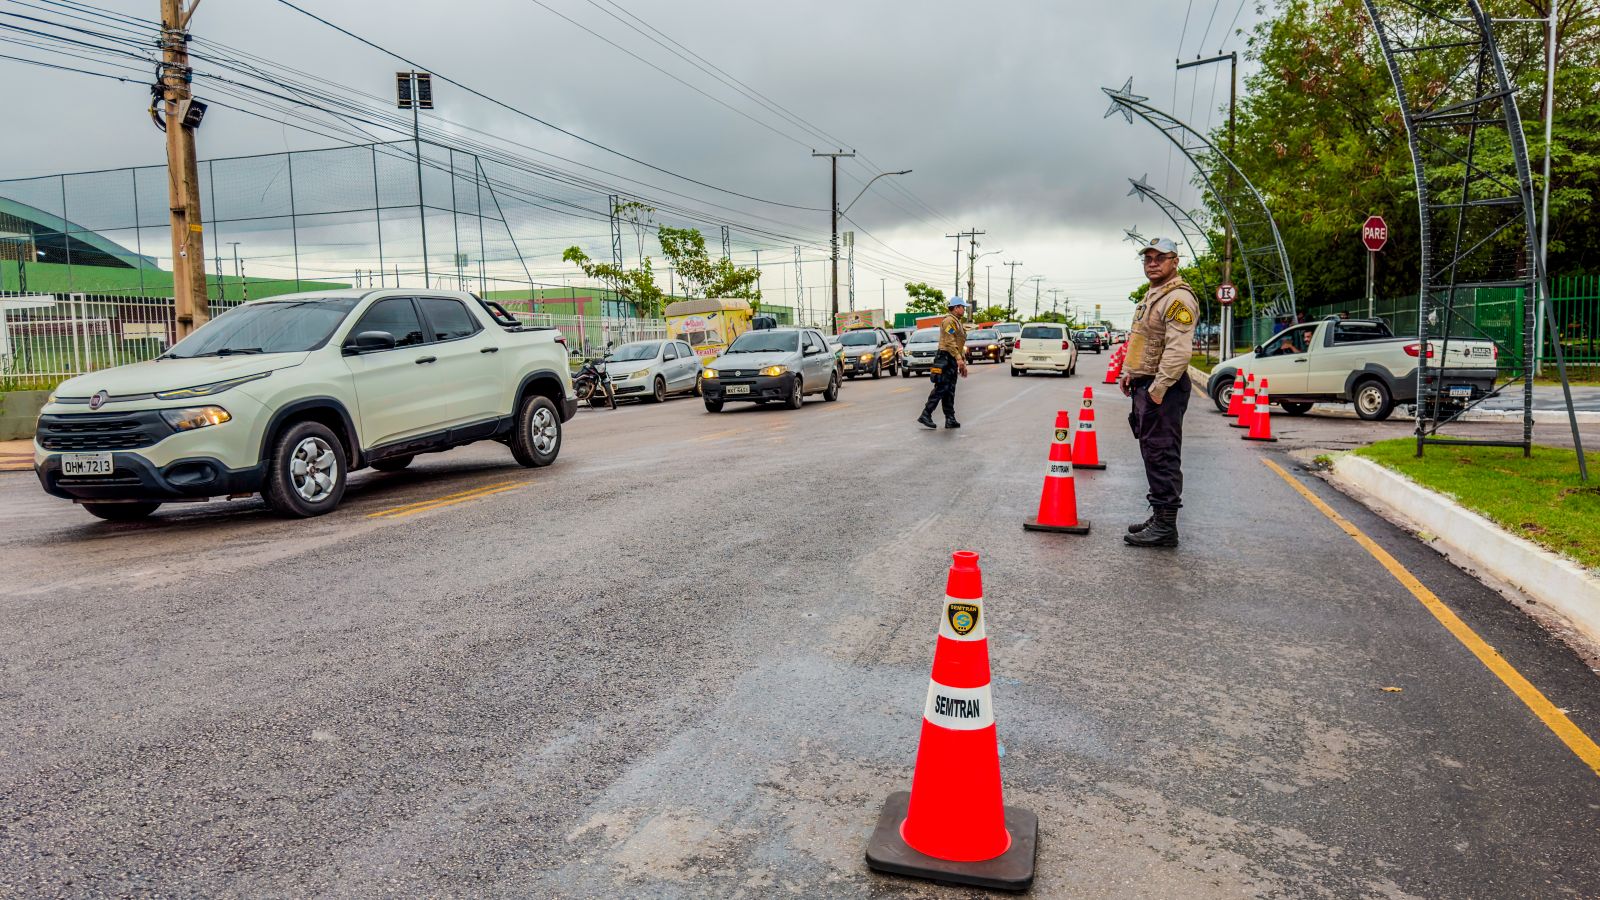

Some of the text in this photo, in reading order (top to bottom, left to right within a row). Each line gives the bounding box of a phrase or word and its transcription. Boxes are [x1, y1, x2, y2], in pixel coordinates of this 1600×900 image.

[1364, 227, 1386, 240] PARE
[950, 604, 977, 612] SEMTRAN
[935, 694, 980, 719] SEMTRAN
